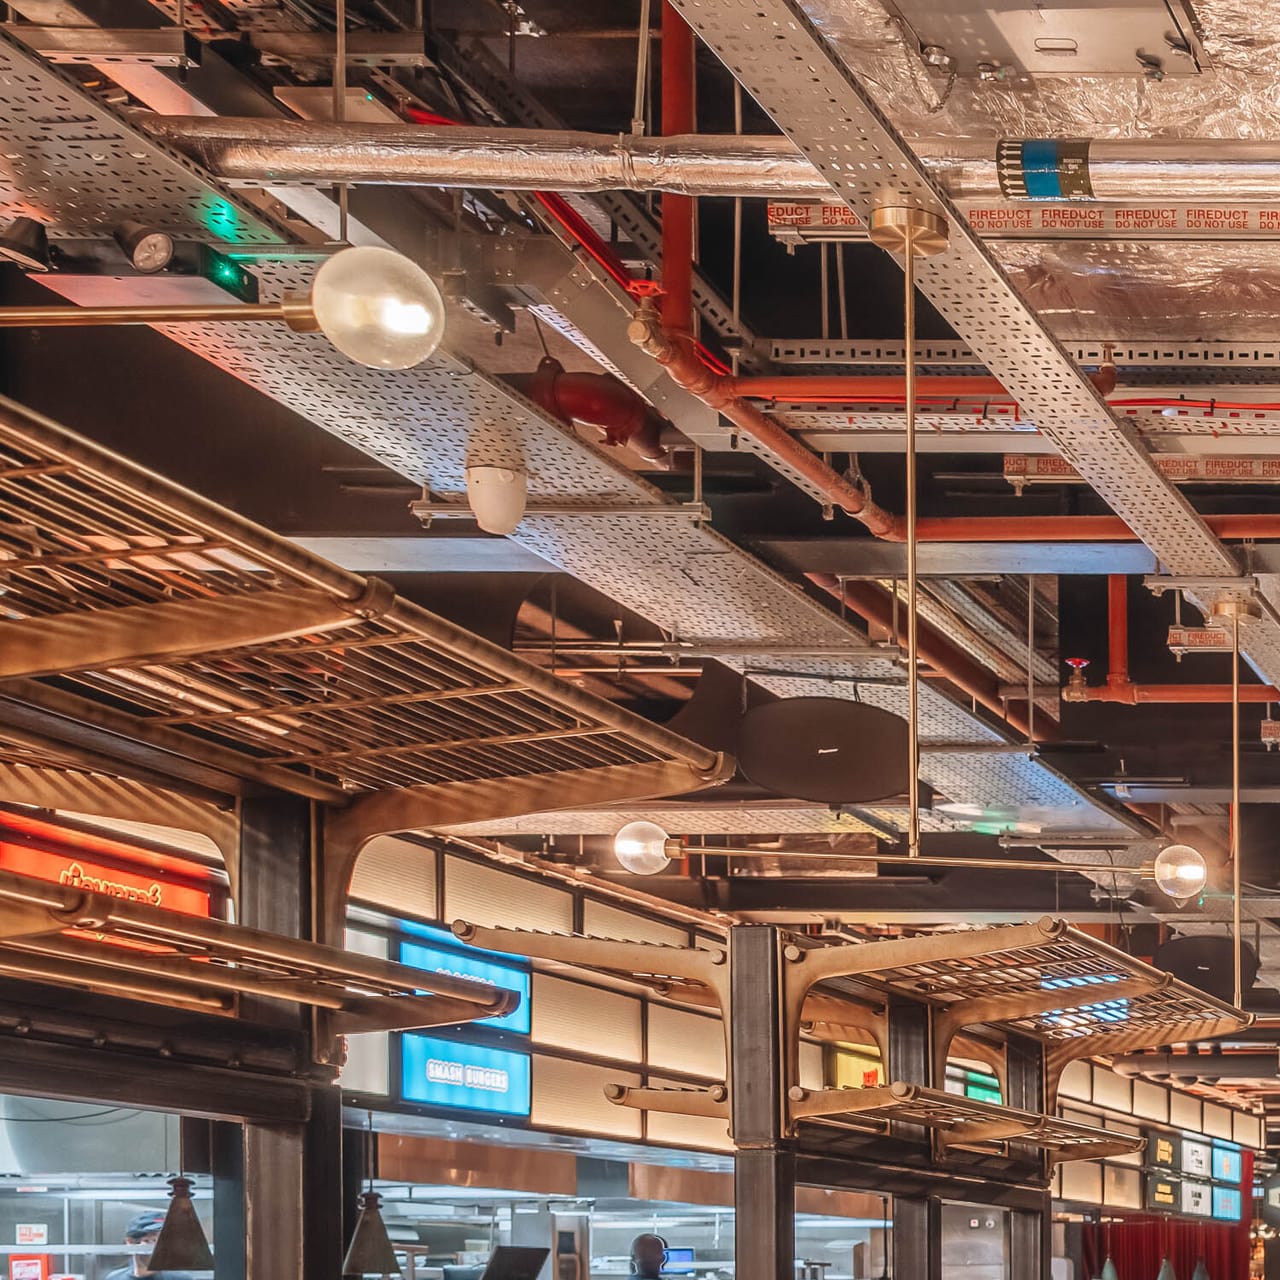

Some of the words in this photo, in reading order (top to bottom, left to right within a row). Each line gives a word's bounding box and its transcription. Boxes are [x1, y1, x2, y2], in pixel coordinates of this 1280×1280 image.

[768, 207, 810, 217] EDUCT
[822, 207, 852, 217] FIRE
[969, 209, 1032, 220] FIREDUCT
[1041, 209, 1104, 219] FIREDUCT
[1115, 209, 1177, 219] FIREDUCT
[1186, 209, 1248, 220] FIREDUCT
[768, 217, 788, 225] NOT
[791, 217, 811, 225] USE
[822, 217, 838, 225] DO
[841, 217, 860, 225] NOT
[970, 220, 985, 229] DO
[988, 220, 1008, 229] NOT
[1012, 220, 1032, 229] USE
[1042, 220, 1057, 229] DO
[1062, 220, 1081, 229] NOT
[1084, 220, 1104, 229] USE
[1115, 220, 1133, 229] DO
[1136, 220, 1154, 229] NOT
[1157, 220, 1177, 229] USE
[1187, 220, 1201, 229] DO
[1205, 220, 1225, 229] NOT
[1228, 220, 1248, 229] USE
[1259, 222, 1274, 231] DO
[1037, 458, 1070, 466] FIRED
[1205, 460, 1254, 468] FIREDUCT
[427, 1060, 463, 1084] SMASH
[465, 1065, 508, 1091] BURGERS
